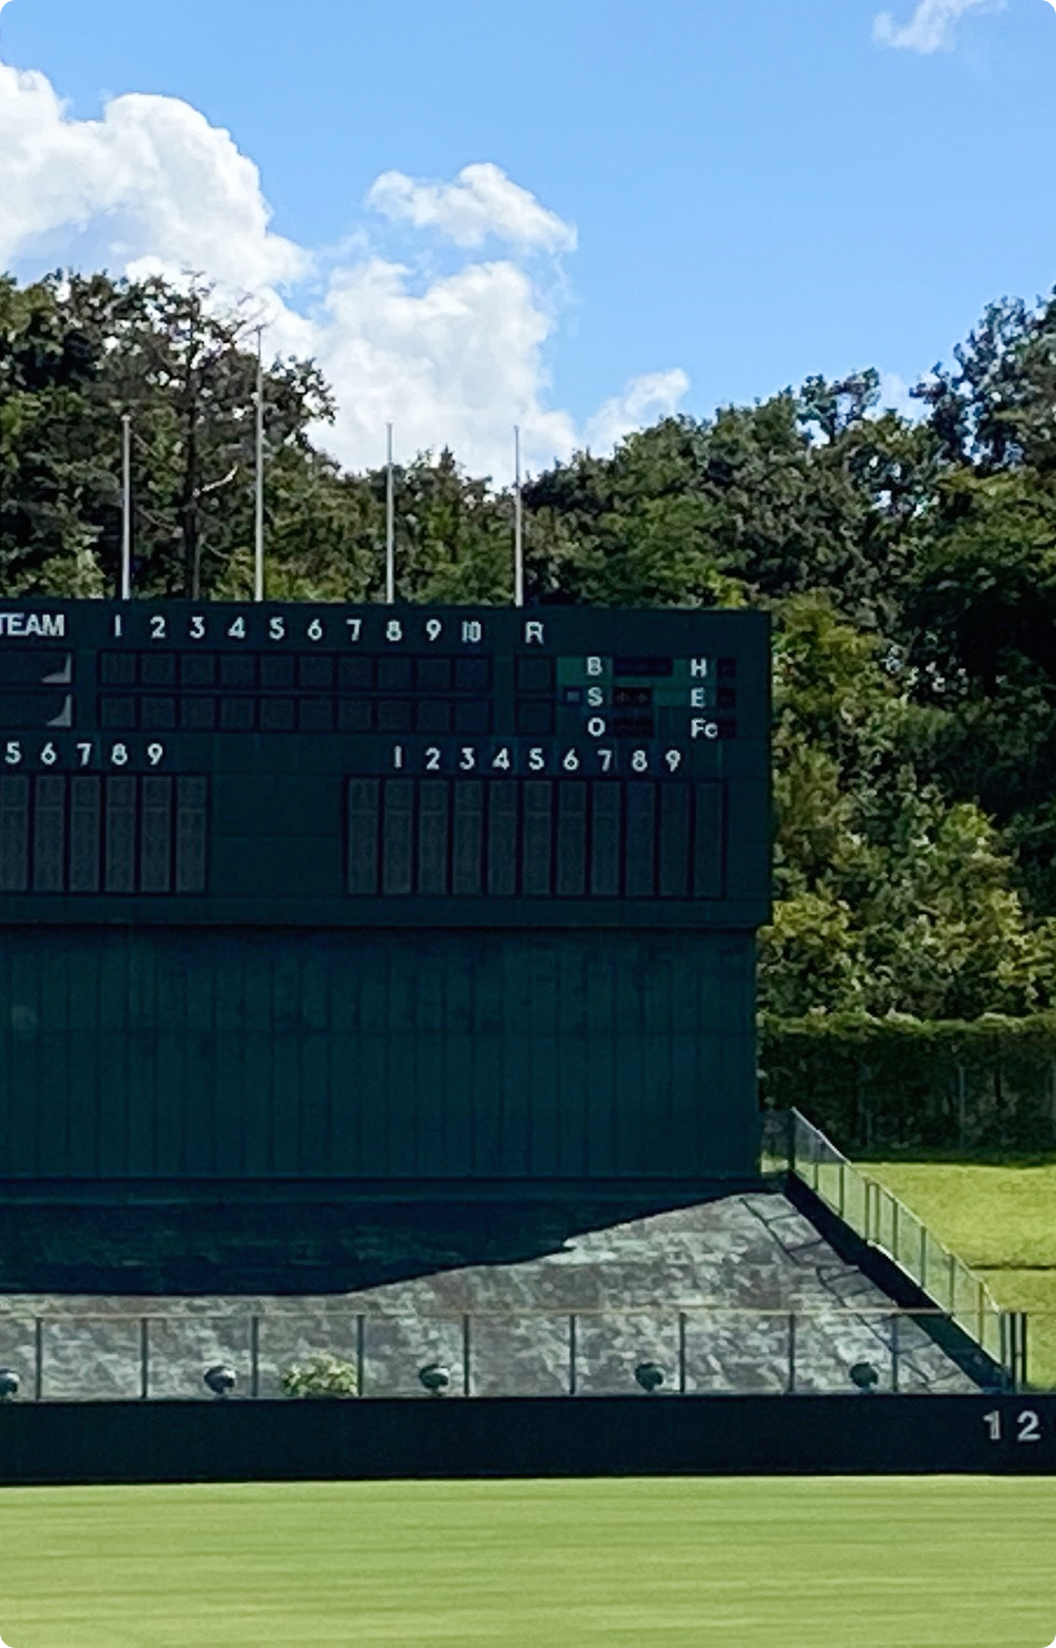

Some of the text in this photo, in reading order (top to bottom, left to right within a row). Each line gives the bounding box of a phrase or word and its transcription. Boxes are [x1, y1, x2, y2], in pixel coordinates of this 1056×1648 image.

[0, 613, 544, 644] TEAM 1 2 3 4 5 6 7 8 9 10 R
[586, 656, 603, 676] B
[690, 658, 707, 678] H
[586, 687, 604, 707] S
[690, 687, 706, 708] E
[587, 717, 606, 737] O
[4, 741, 163, 766] 5 6 7 8 9
[394, 745, 681, 773] 1 2 3 4 5 6 7 8 9
